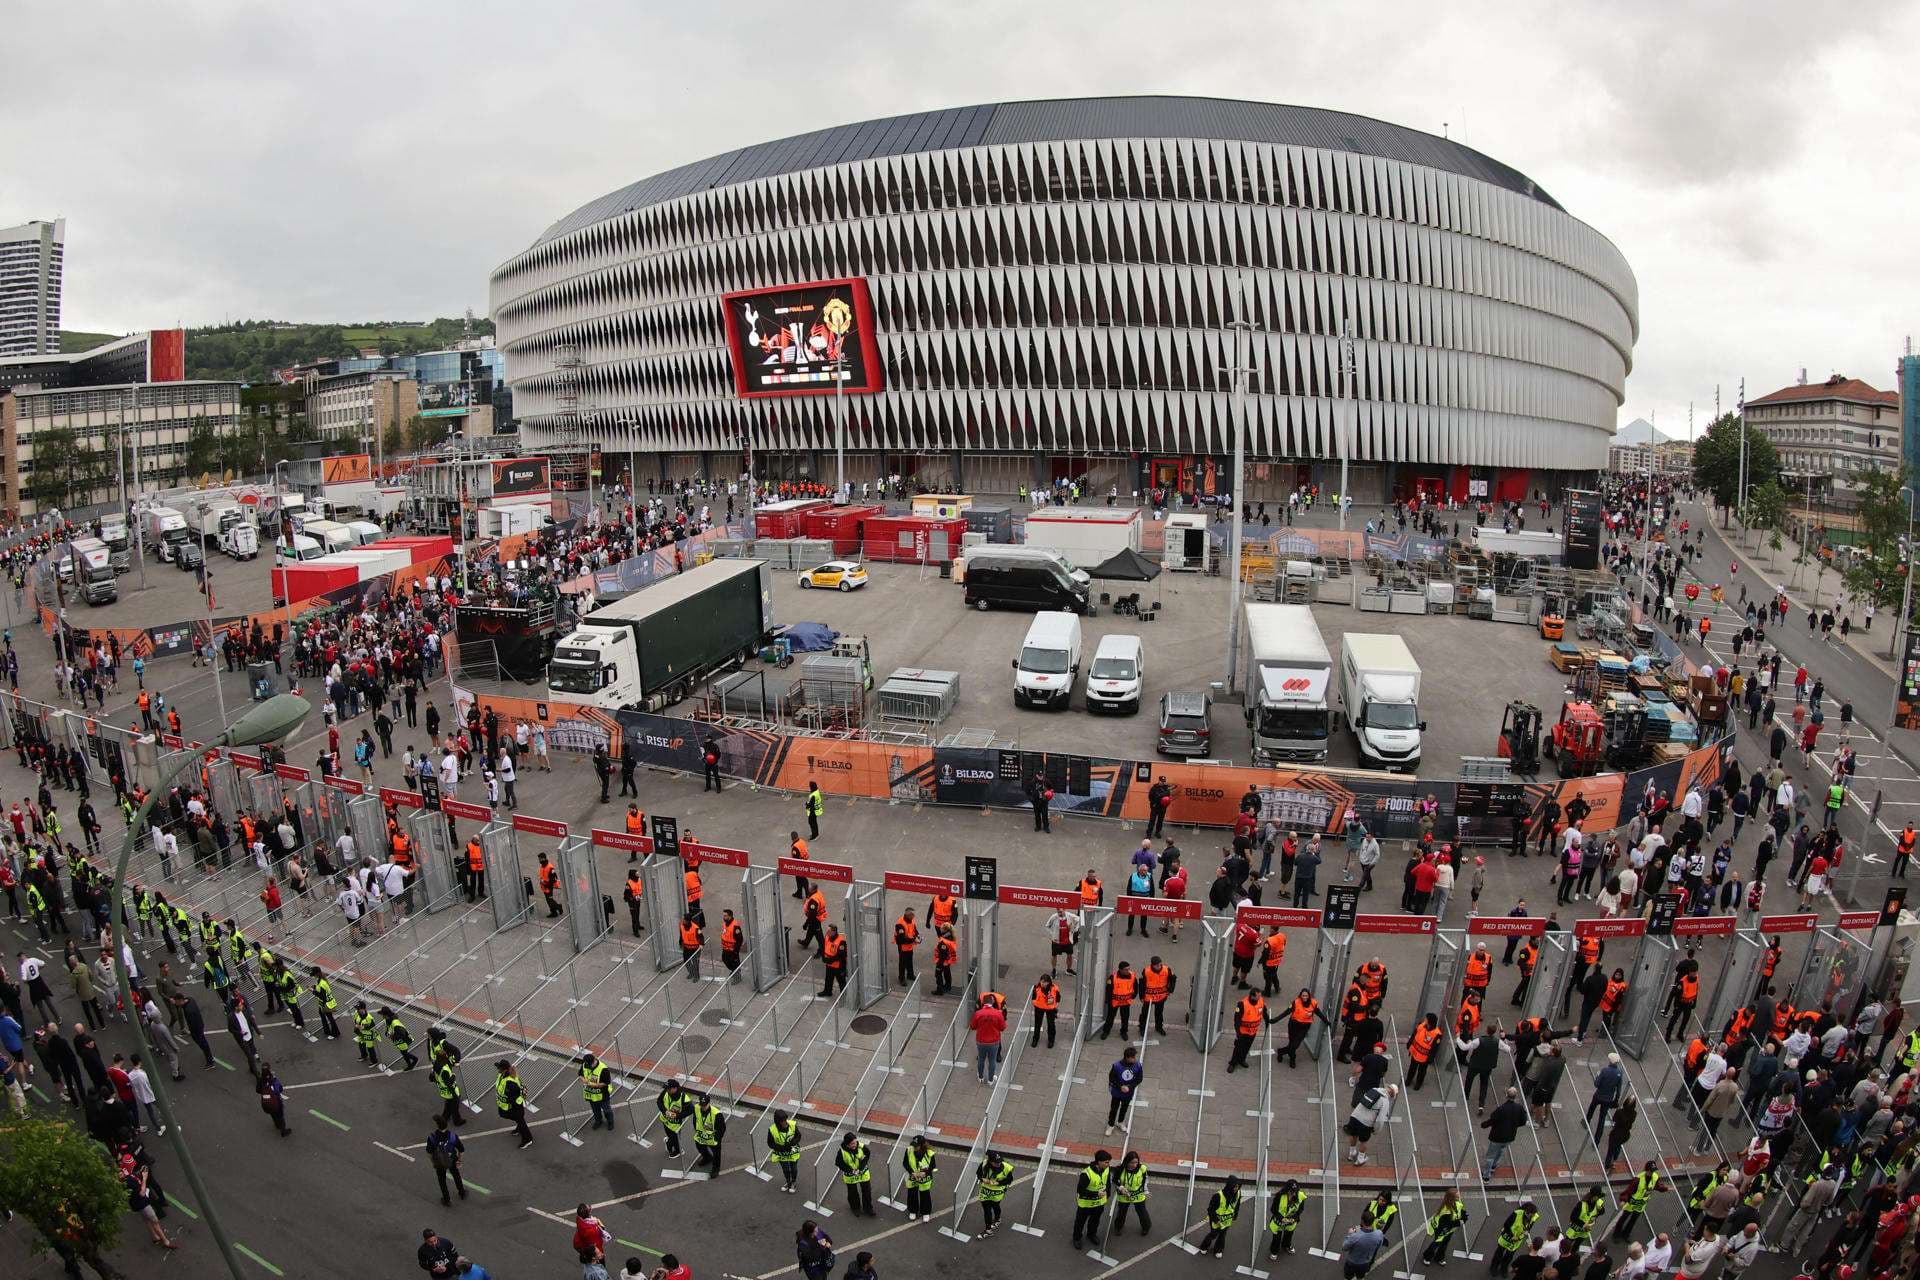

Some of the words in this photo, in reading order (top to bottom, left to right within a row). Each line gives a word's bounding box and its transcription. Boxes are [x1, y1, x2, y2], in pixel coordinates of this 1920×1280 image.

[916, 530, 925, 560] RENTAL
[614, 837, 644, 847] ENTRANCE
[699, 850, 729, 860] WELCOME
[783, 864, 809, 872] Activate
[809, 867, 840, 876] Bluetooth
[1013, 893, 1027, 901] RED
[1028, 894, 1068, 904] ENTRANCE
[1140, 903, 1178, 913] WELCOME
[1243, 912, 1272, 920] Activate
[1273, 913, 1306, 921] Bluetooth
[1594, 924, 1626, 932] WELCOME
